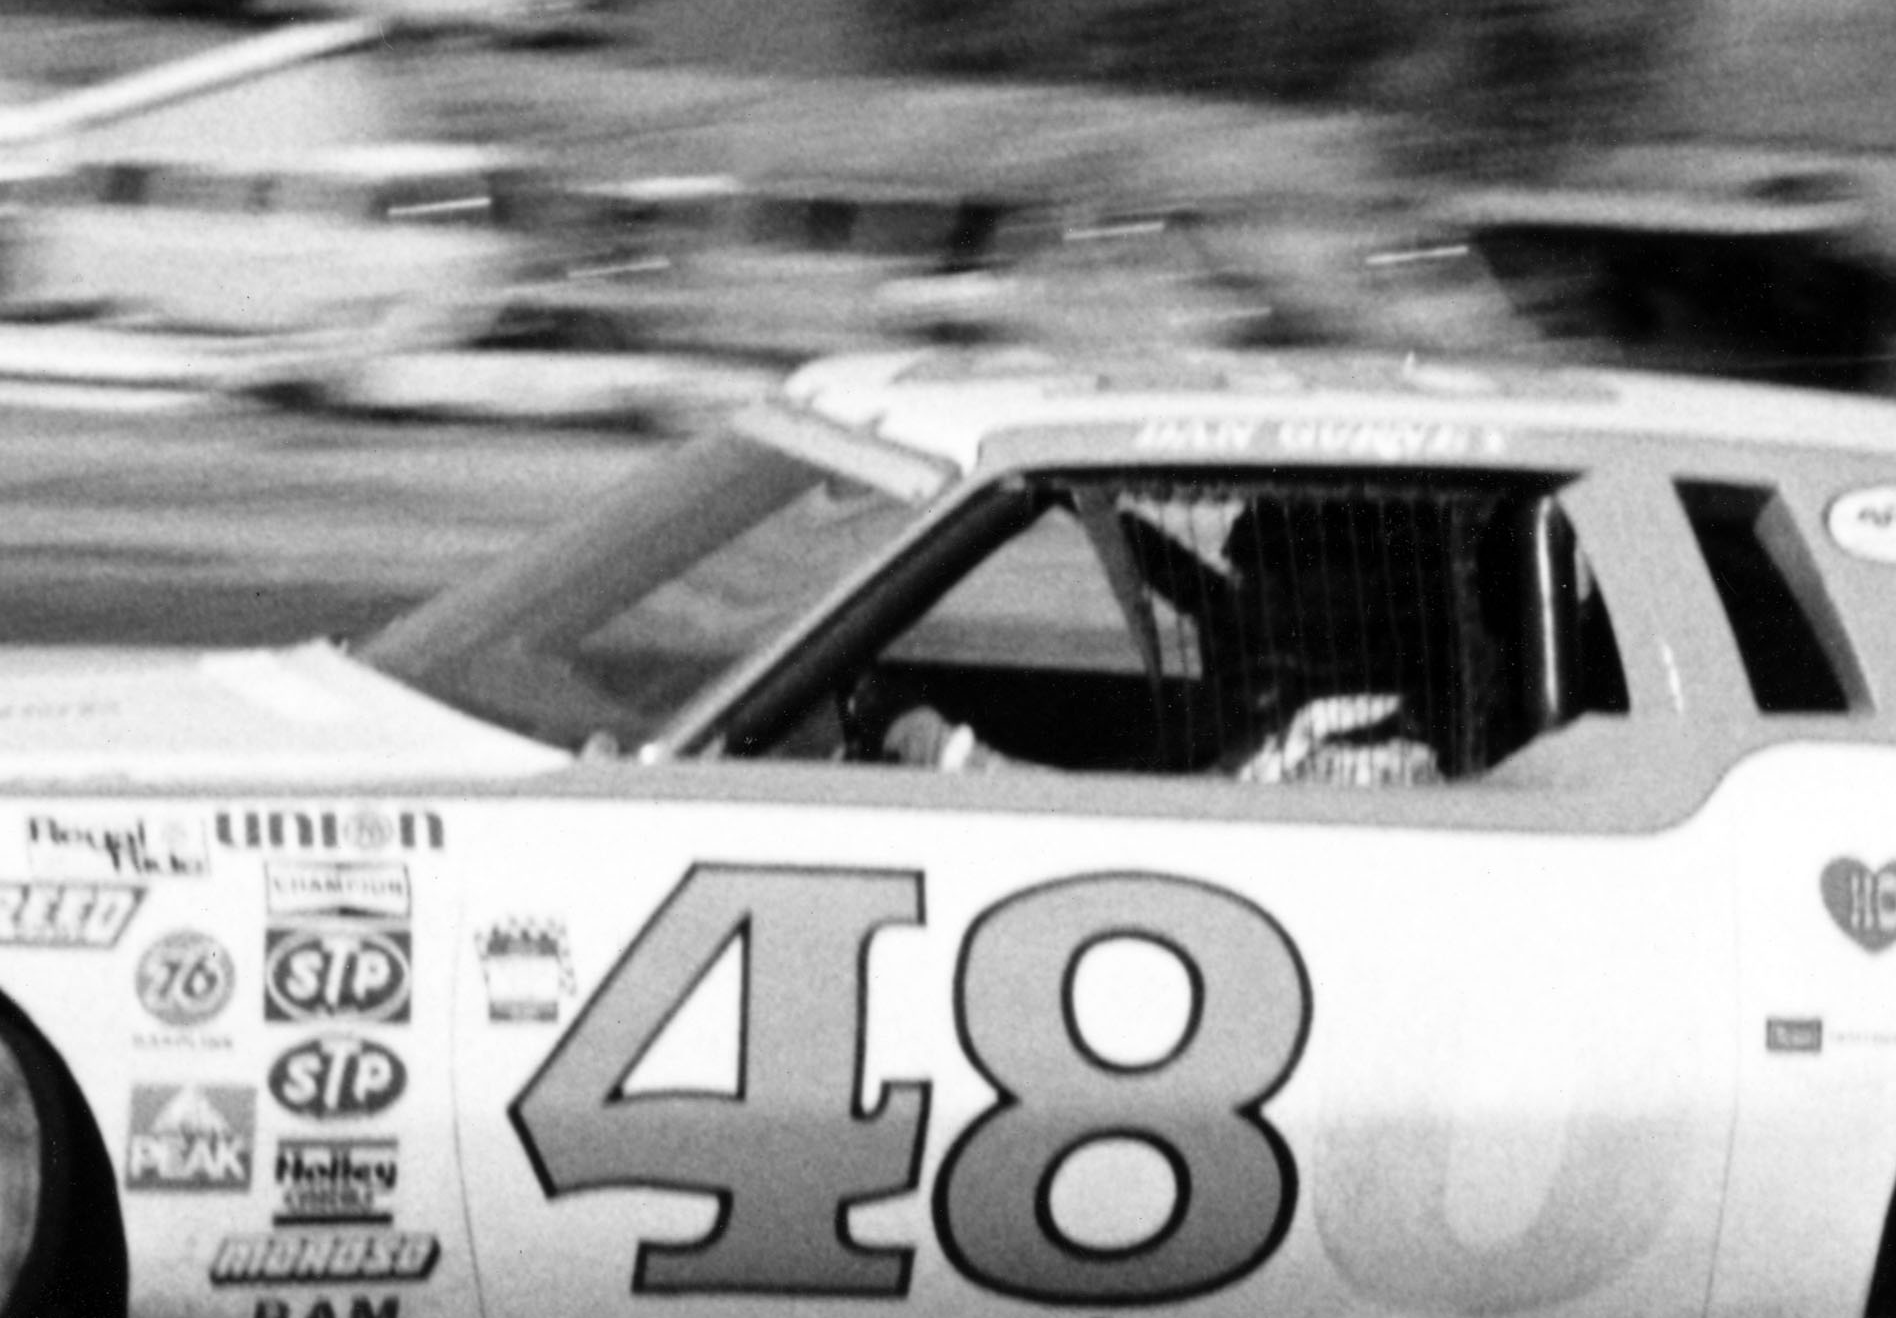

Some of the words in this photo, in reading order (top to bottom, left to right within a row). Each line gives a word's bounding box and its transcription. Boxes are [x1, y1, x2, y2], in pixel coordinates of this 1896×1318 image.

[270, 878, 406, 895] CHAMPION
[144, 946, 226, 1012] 76
[285, 933, 393, 1008] STP
[281, 1037, 393, 1110] STP
[506, 860, 1312, 1310] 48
[130, 1131, 248, 1180] PEAK
[274, 1146, 398, 1189] Holley
